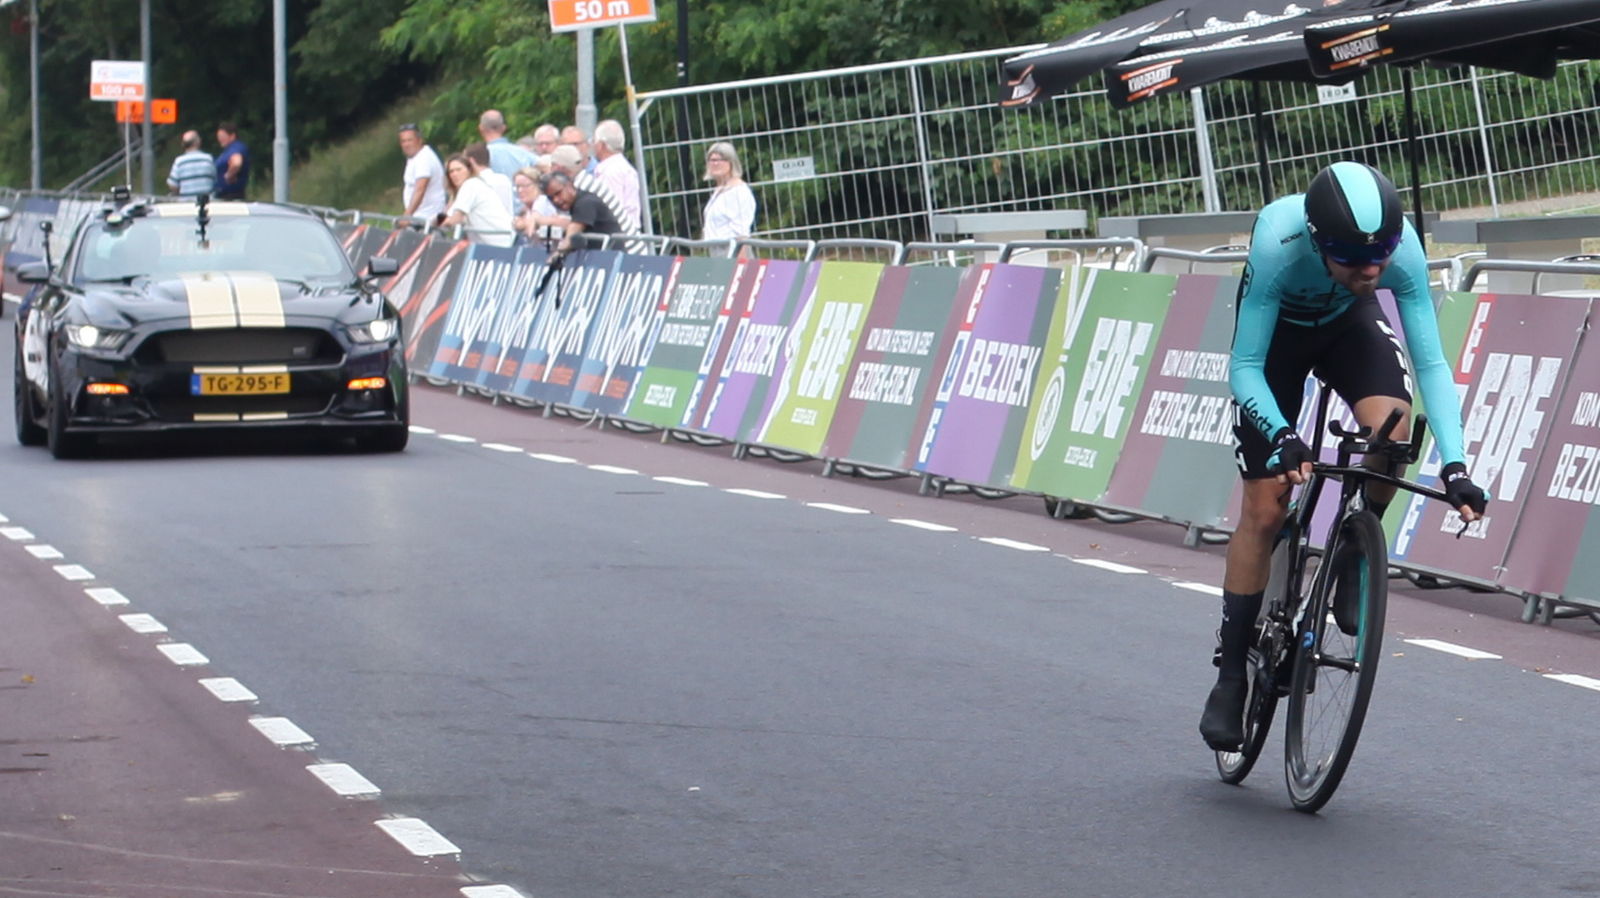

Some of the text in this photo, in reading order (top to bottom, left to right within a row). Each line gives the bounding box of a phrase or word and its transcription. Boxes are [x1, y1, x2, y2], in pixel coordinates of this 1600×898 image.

[574, 0, 630, 21] 50 m
[734, 323, 788, 377] BEZOEK
[797, 301, 863, 400] EDE
[958, 338, 1041, 407] BEZOEK
[1070, 317, 1154, 439] EDE
[206, 376, 283, 392] TG-295-F
[1568, 391, 1599, 428] KOM
[1463, 353, 1563, 502] EDE
[1547, 443, 1600, 506] BEZO
